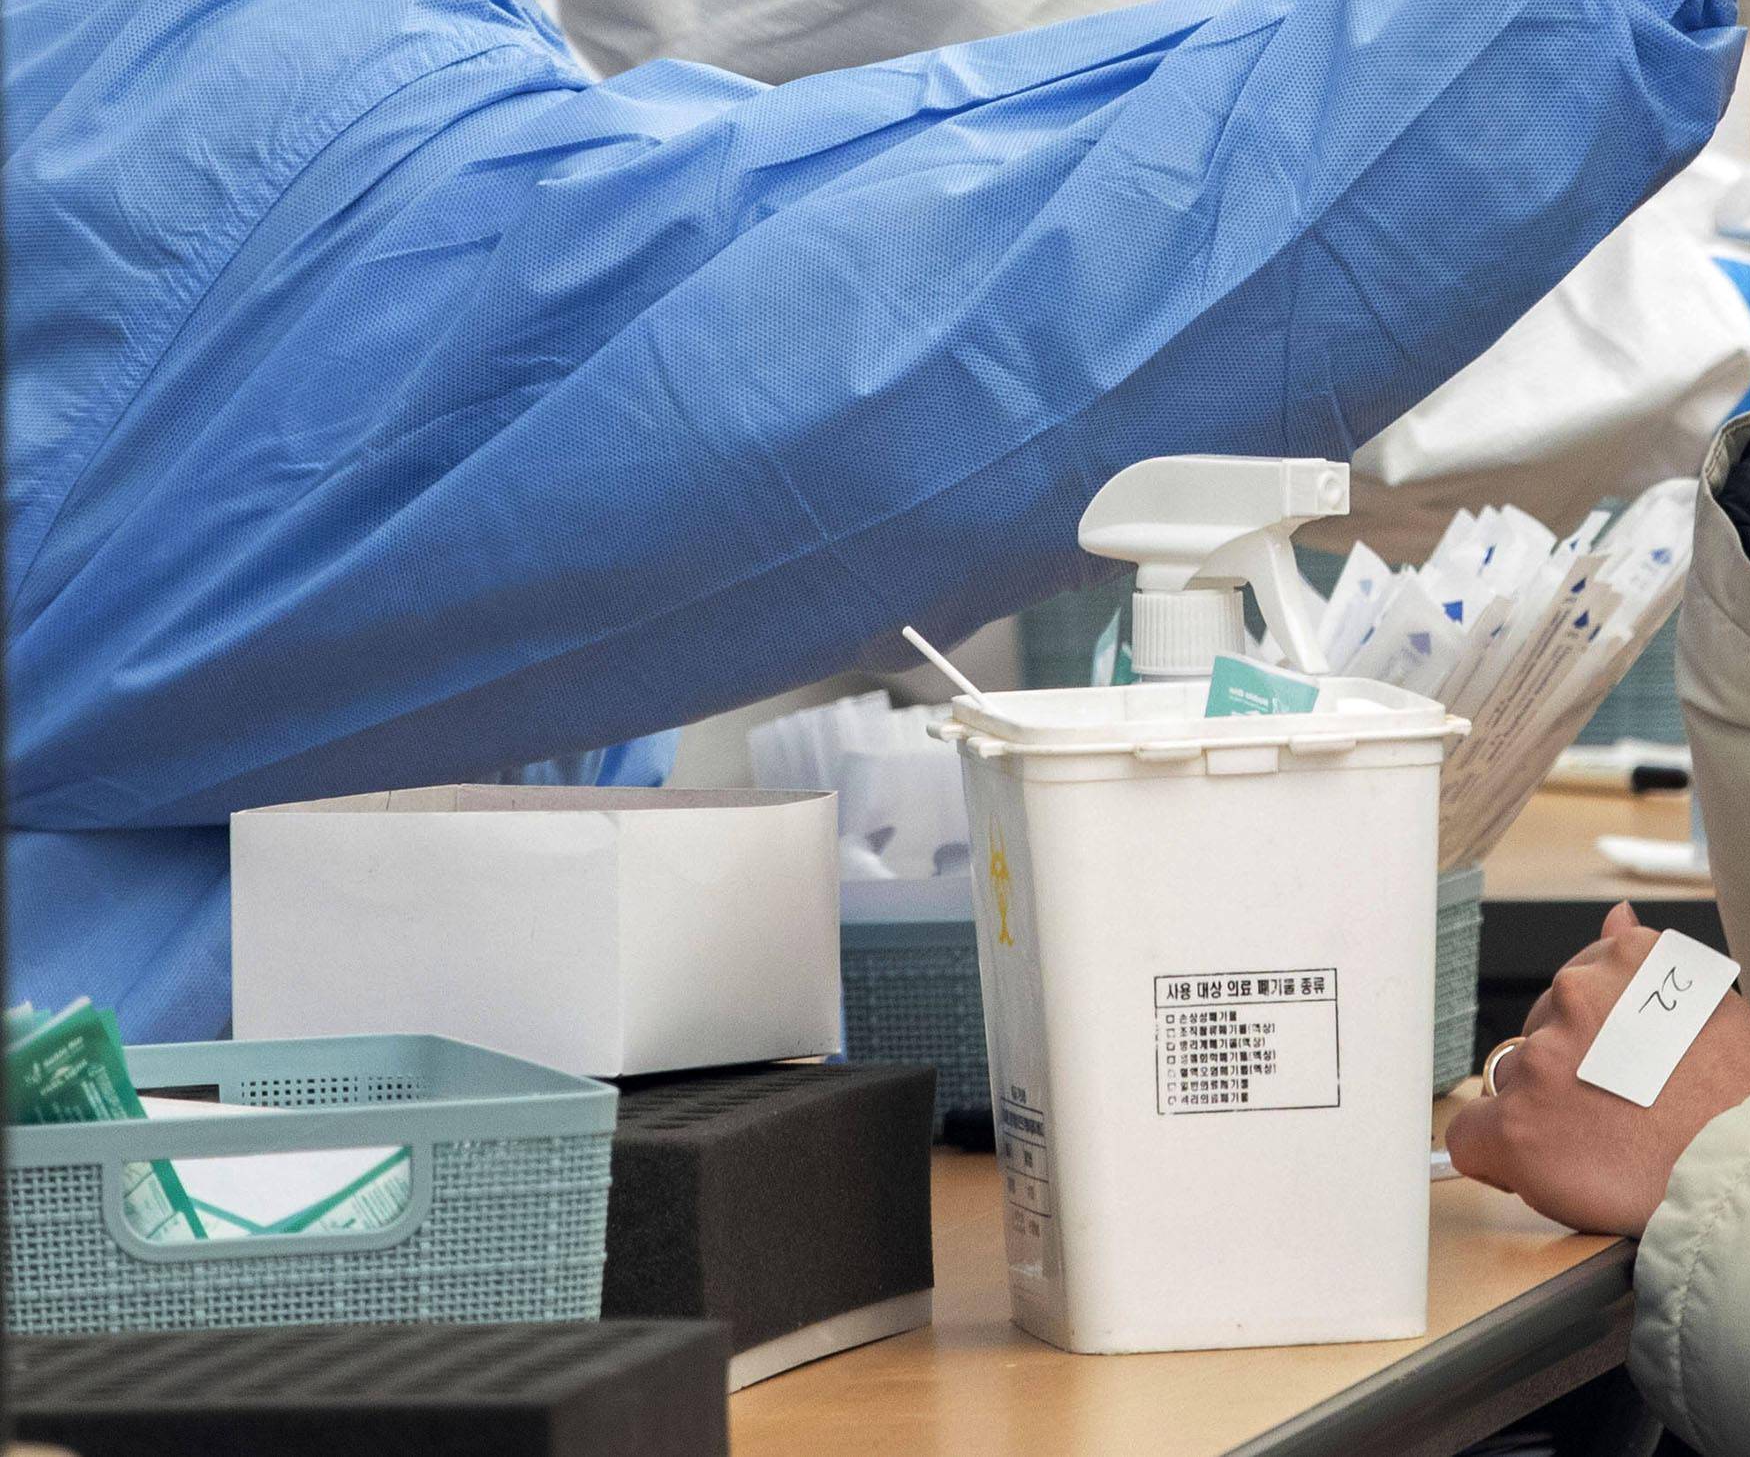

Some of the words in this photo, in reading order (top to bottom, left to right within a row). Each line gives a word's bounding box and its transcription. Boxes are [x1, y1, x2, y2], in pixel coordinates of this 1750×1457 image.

[1166, 983, 1192, 1000] 사용
[1197, 981, 1223, 999] 대상
[1227, 980, 1253, 997] 의료
[1257, 978, 1296, 996] 폐기물
[1300, 976, 1326, 995] 종류
[1638, 966, 1693, 1014] 22
